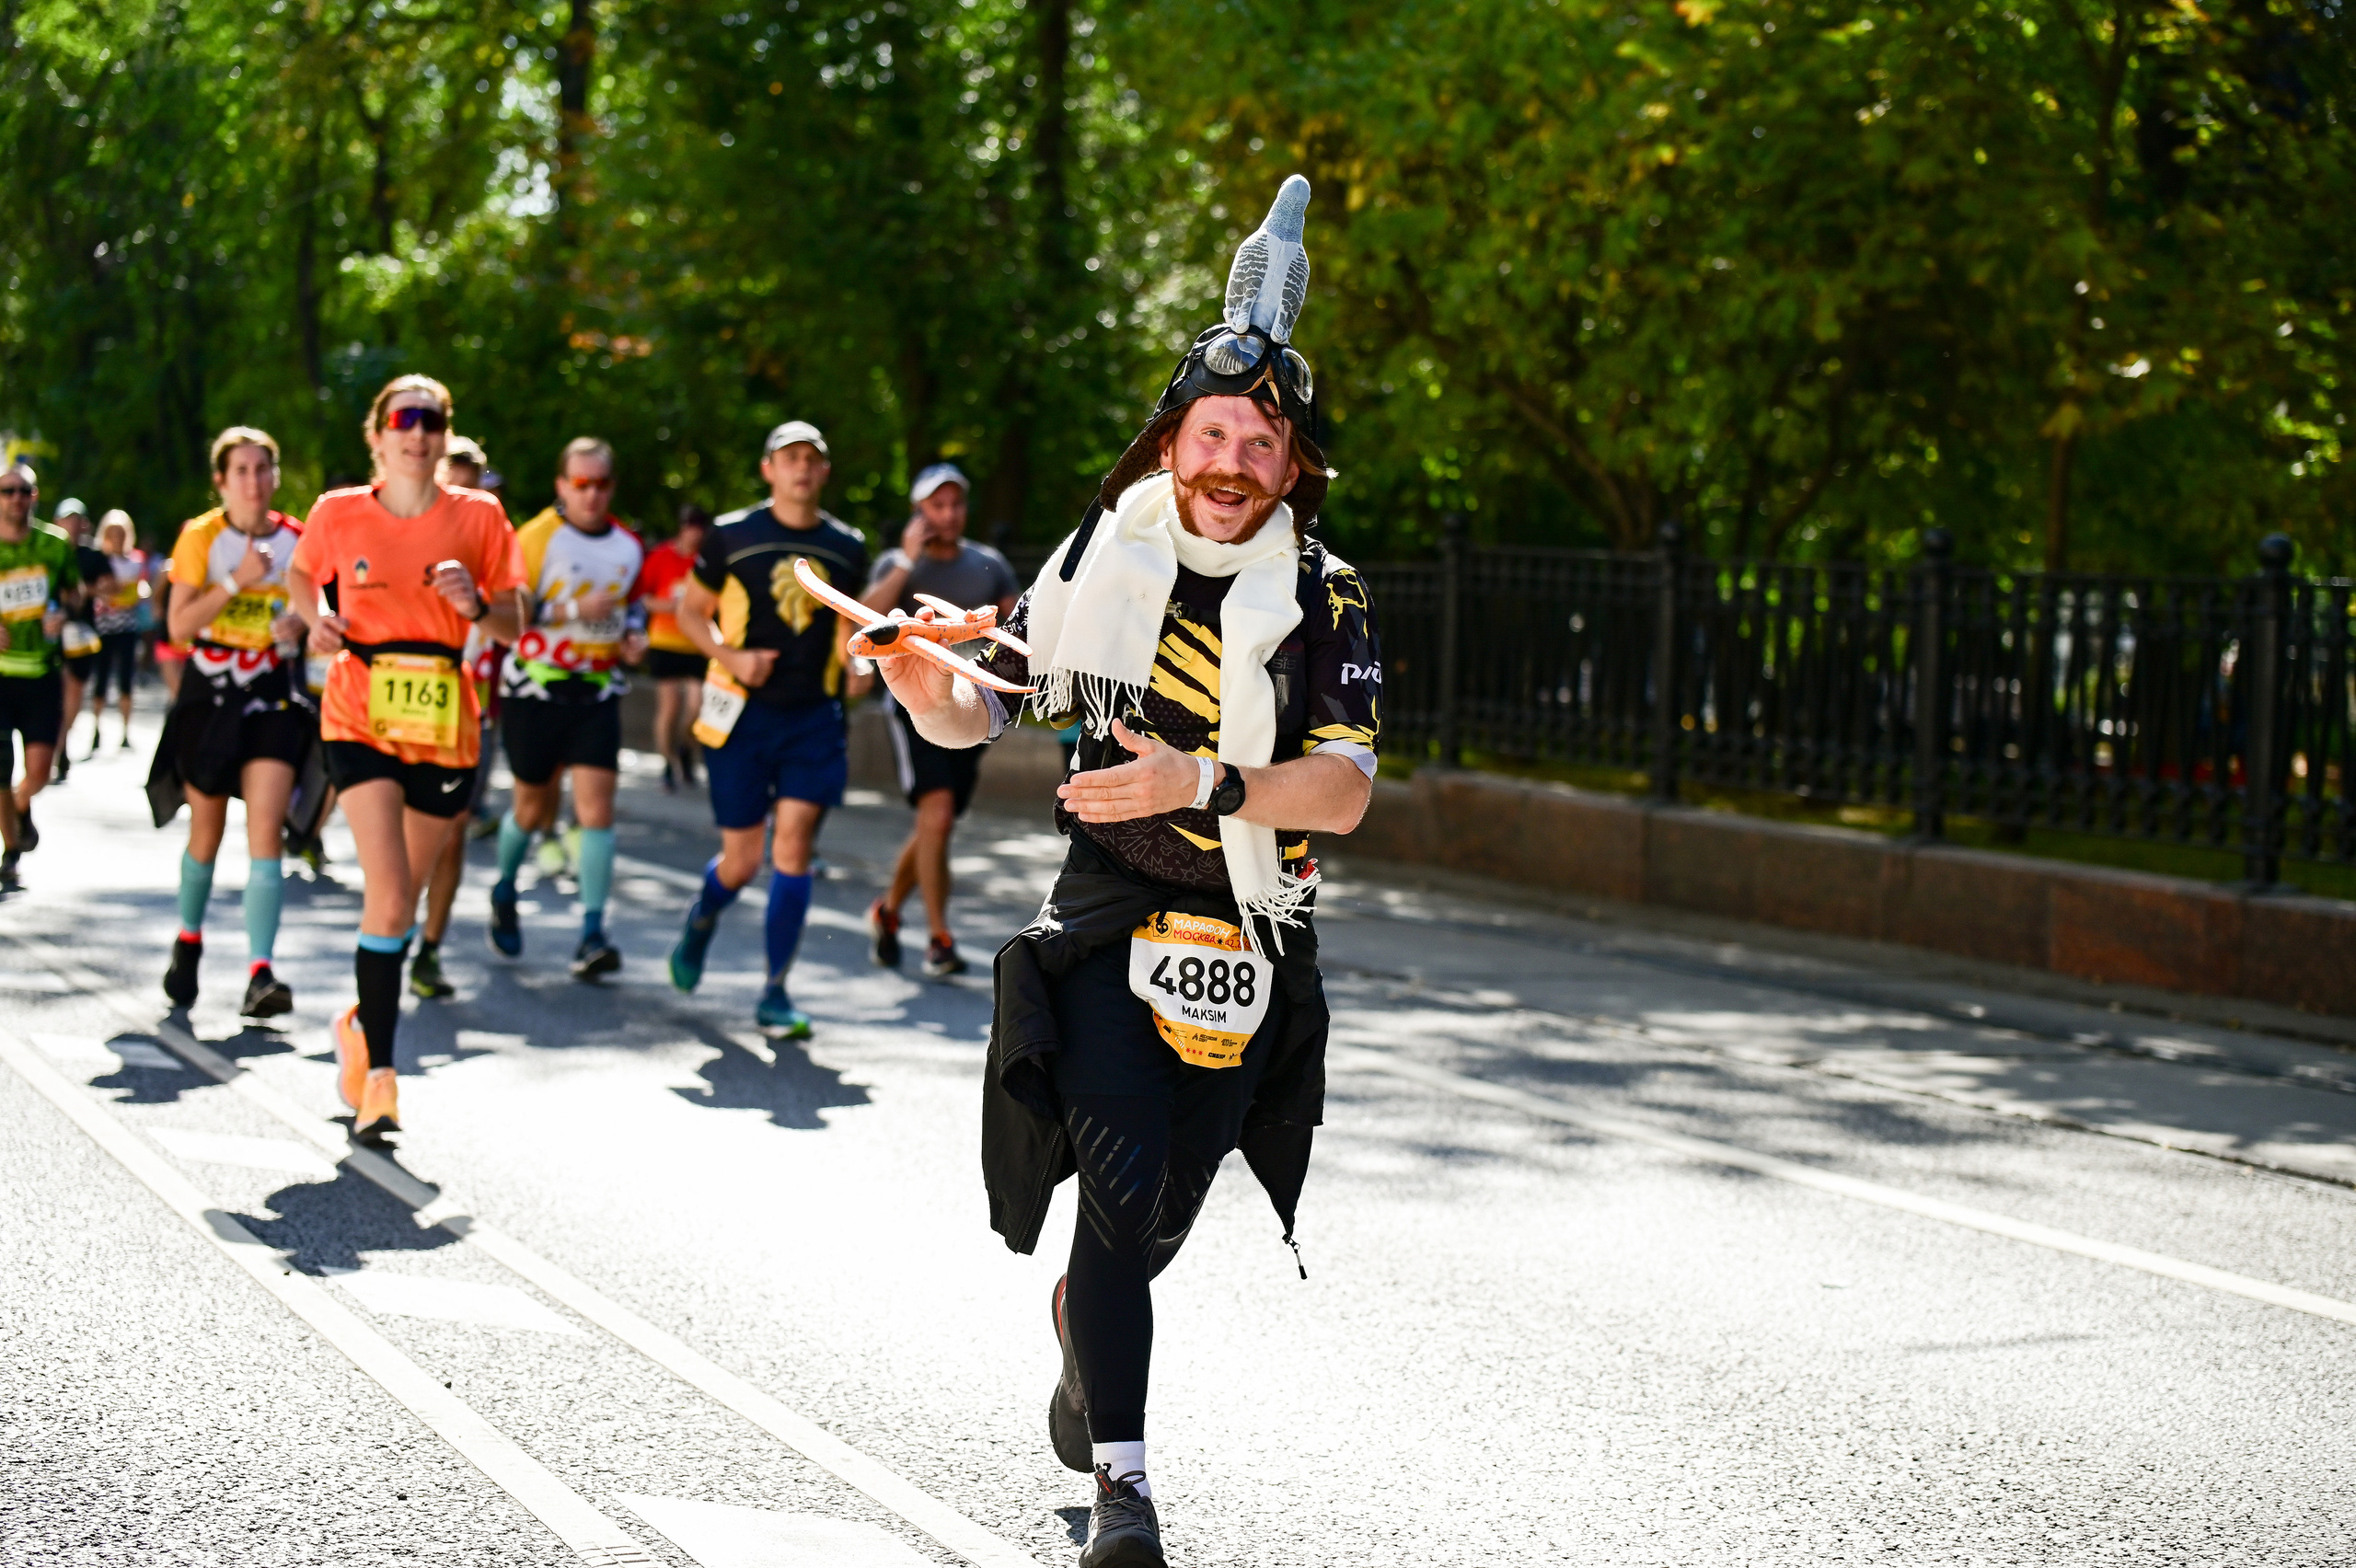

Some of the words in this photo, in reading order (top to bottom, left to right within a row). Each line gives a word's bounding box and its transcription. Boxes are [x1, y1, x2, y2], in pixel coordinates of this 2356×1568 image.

[384, 678, 449, 710] 1163
[1173, 918, 1230, 939] МАРАФОН
[1173, 929, 1217, 945] МОСКВА
[1149, 955, 1256, 1008] 4888
[1182, 1004, 1227, 1023] MAKSIM
